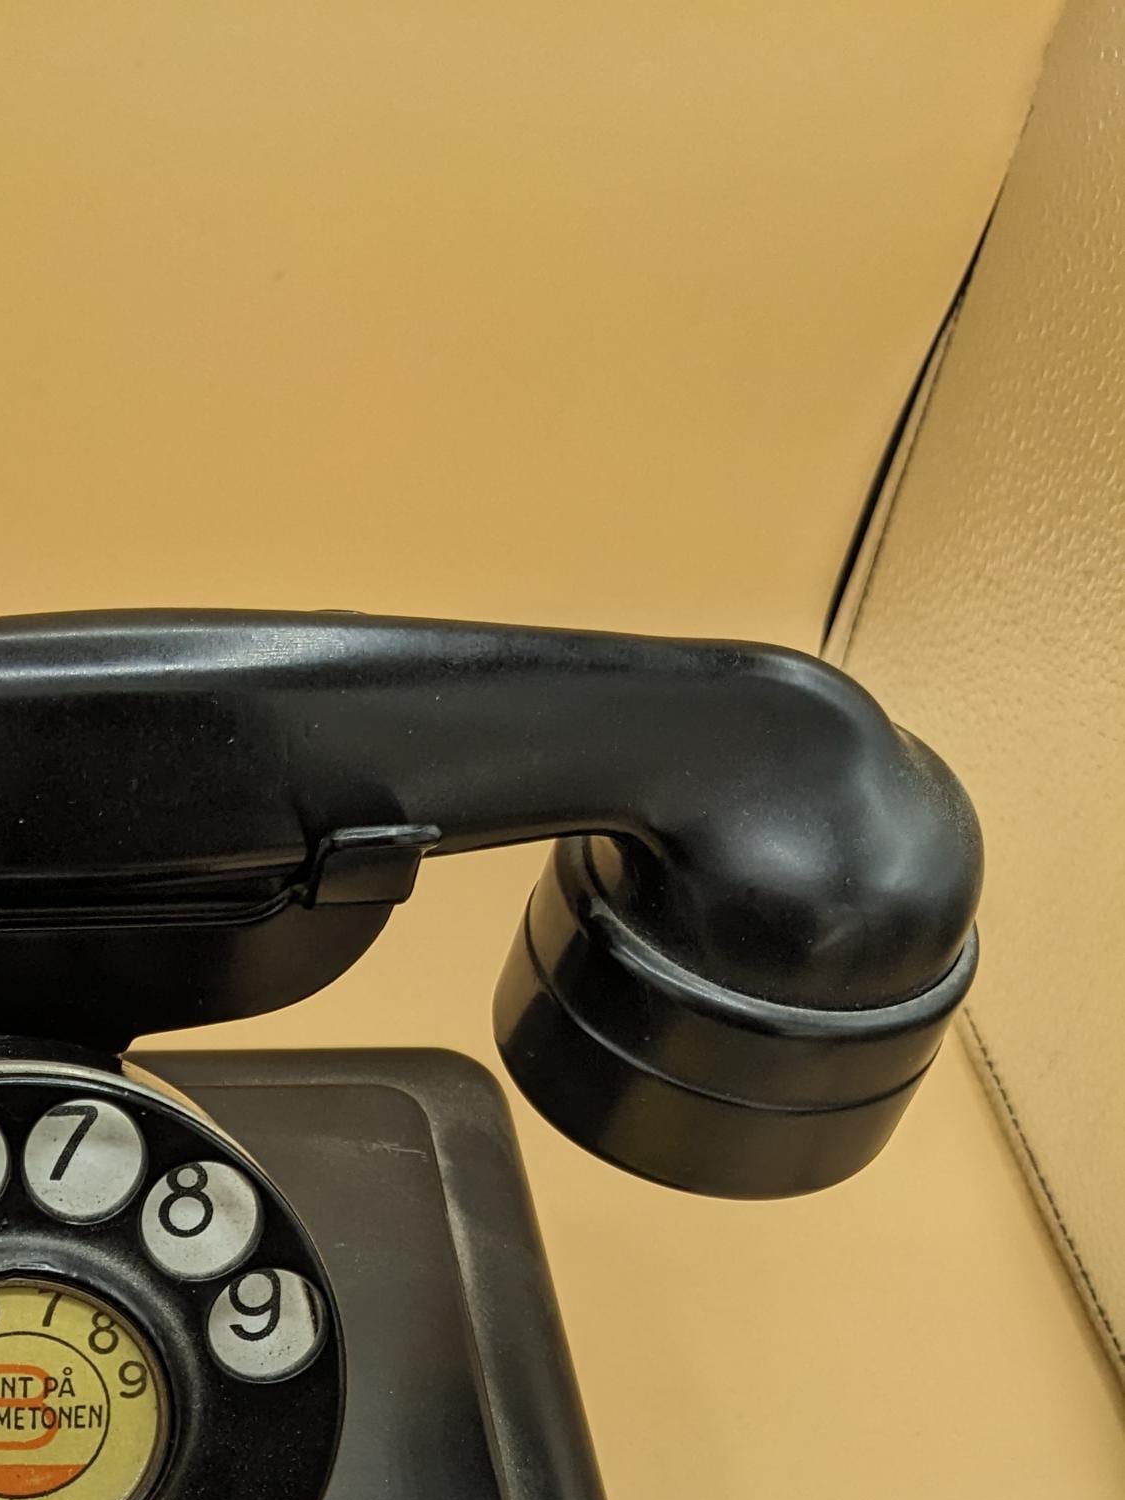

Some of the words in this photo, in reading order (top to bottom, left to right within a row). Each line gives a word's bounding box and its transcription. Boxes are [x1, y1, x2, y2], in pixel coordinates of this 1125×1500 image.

[46, 1104, 98, 1181] 7
[158, 1163, 213, 1237] 8
[38, 1290, 62, 1327] 7
[229, 1270, 280, 1341] 9
[88, 1311, 118, 1354] 8
[43, 1367, 75, 1399] PÅ
[118, 1360, 147, 1399] 9
